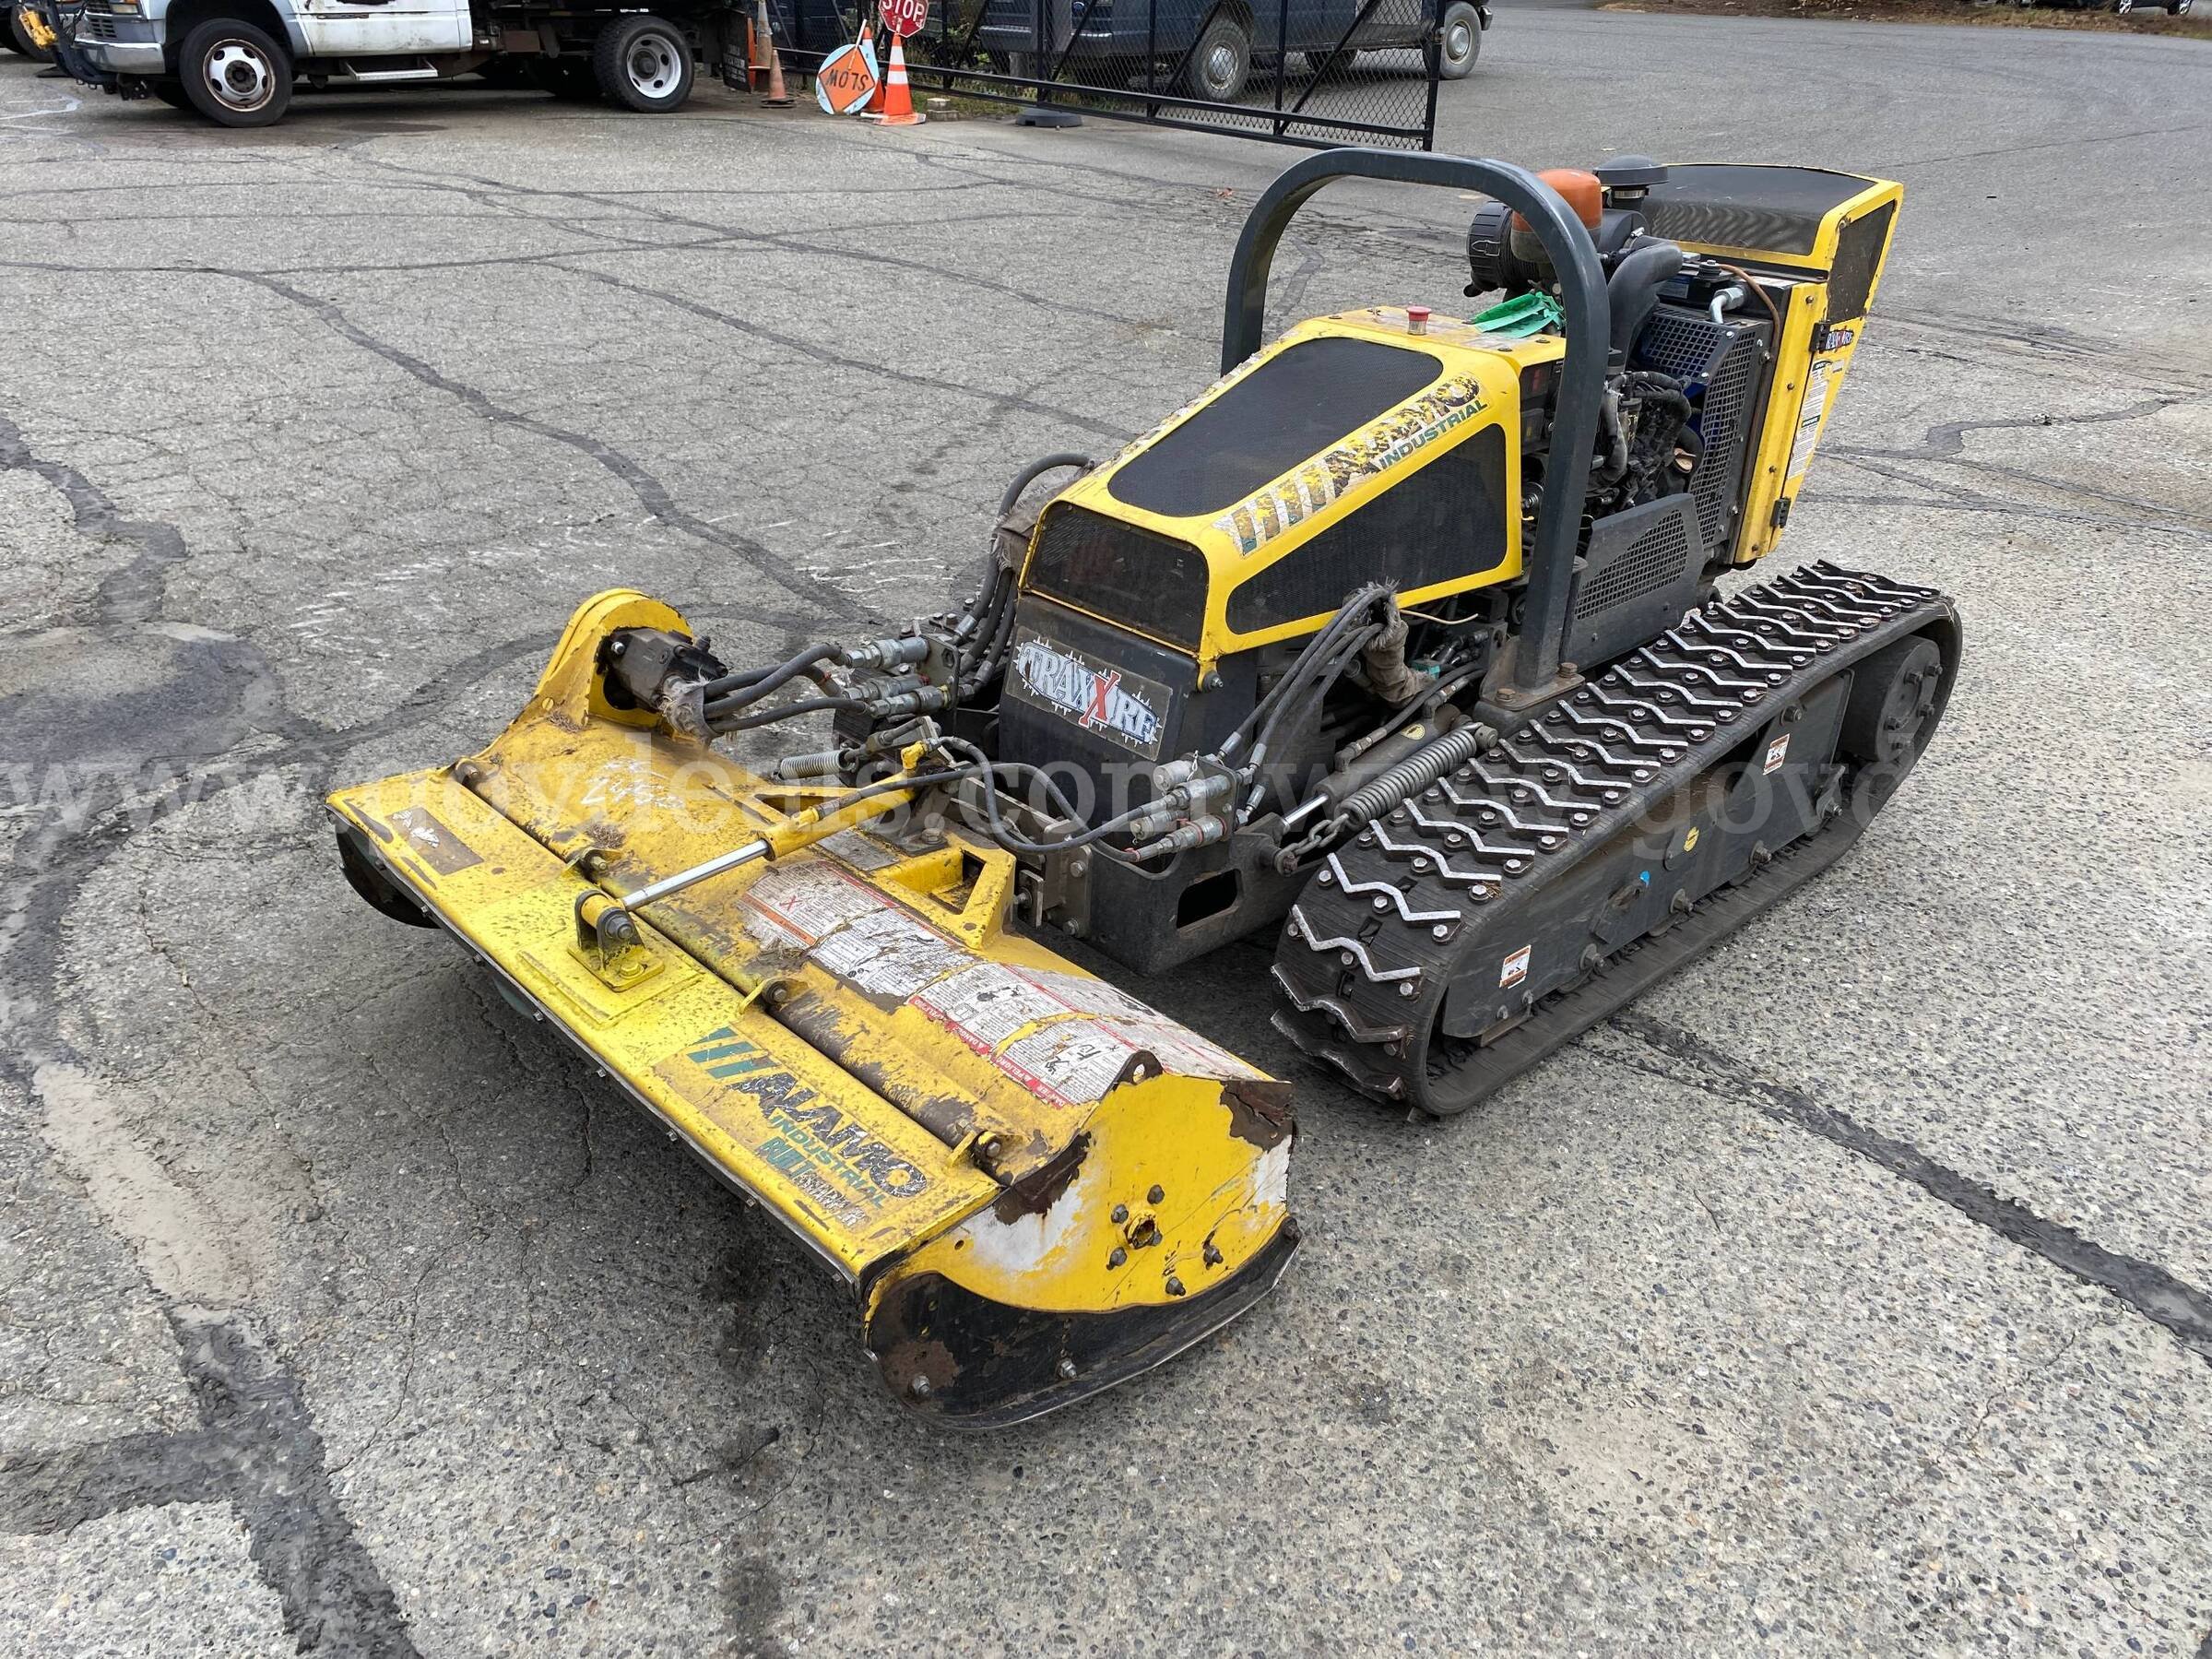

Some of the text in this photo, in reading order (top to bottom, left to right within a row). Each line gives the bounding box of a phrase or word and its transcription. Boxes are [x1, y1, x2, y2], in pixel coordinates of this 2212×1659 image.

[825, 68, 869, 90] SLOW
[1378, 399, 1488, 471] INDUSTRIAL
[726, 1072, 928, 1197] ALAMO
[767, 1114, 887, 1210] INDUSTRIAL
